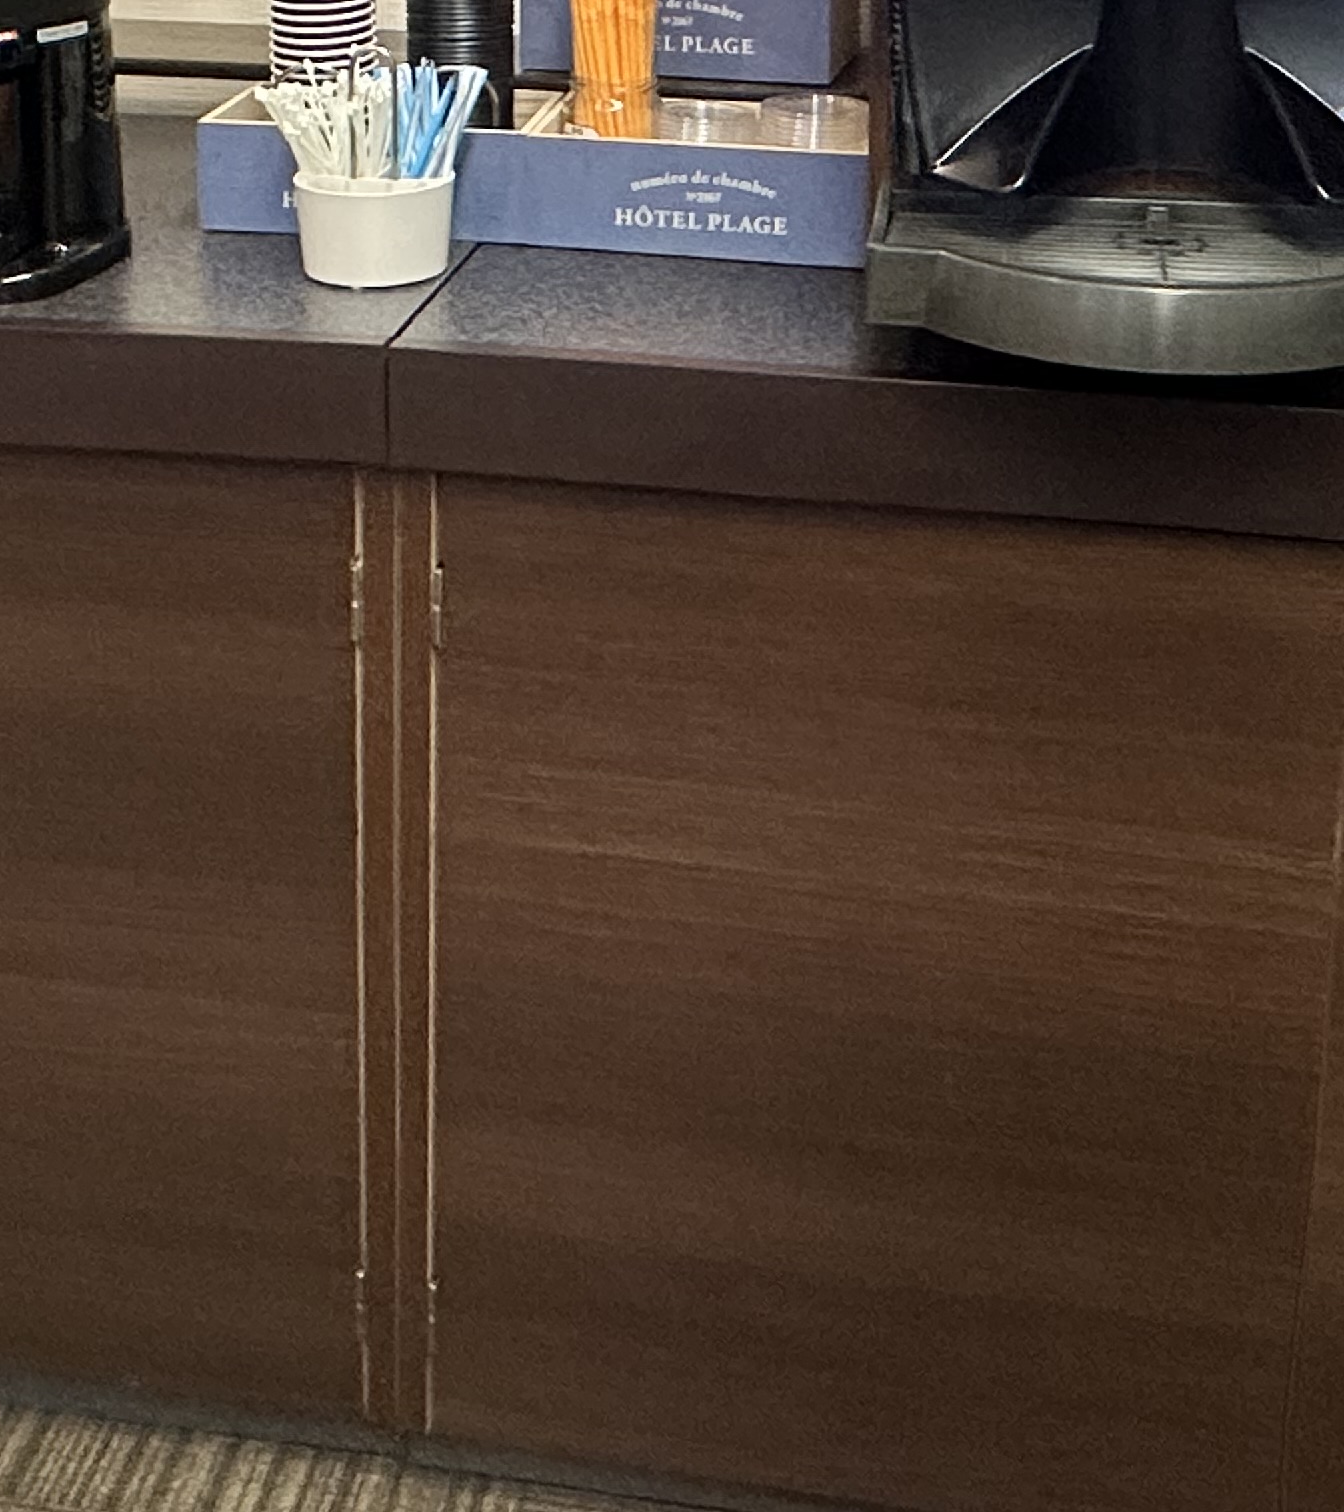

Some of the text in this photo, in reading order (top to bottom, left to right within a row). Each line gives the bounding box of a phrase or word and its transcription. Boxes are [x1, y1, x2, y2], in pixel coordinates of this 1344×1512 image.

[682, 36, 755, 55] PLAGE
[615, 205, 788, 235] HÔTEL PLAGE
